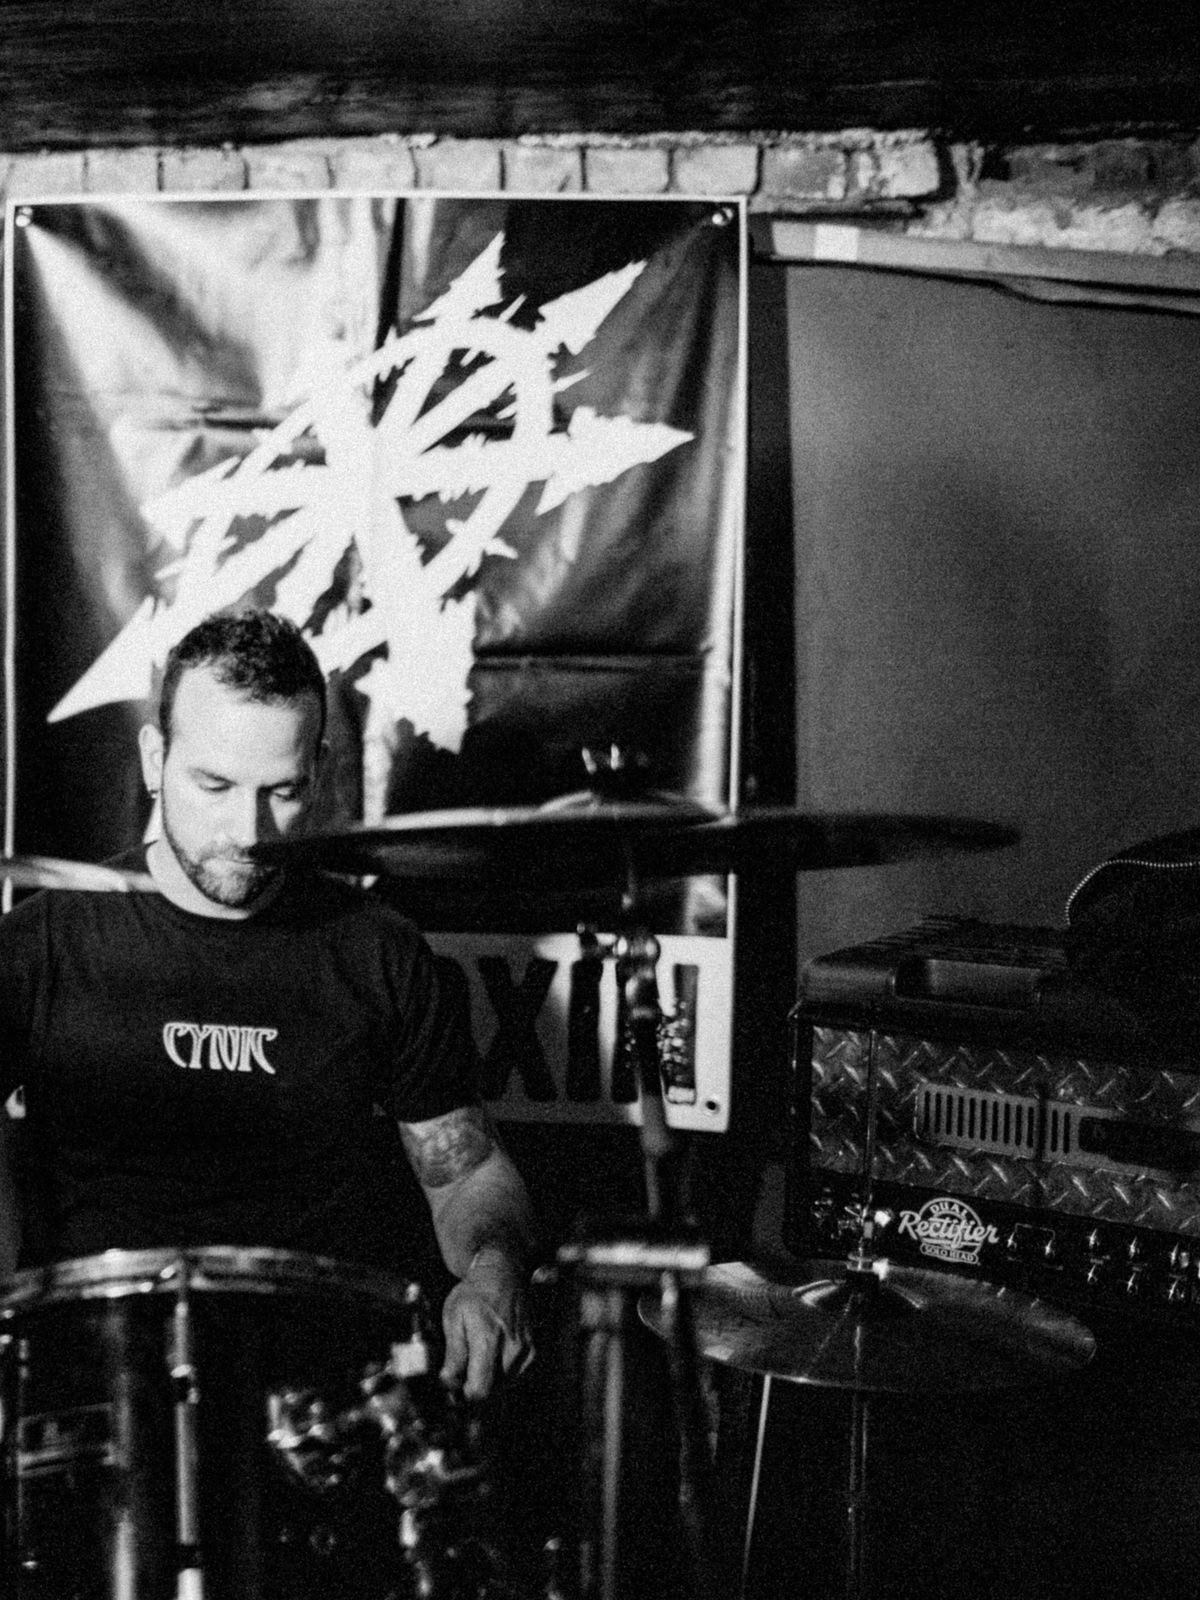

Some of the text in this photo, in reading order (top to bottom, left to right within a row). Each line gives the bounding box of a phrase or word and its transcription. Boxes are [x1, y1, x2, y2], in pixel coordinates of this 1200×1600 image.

[163, 1022, 278, 1075] CYNIC
[929, 1201, 969, 1218] DUAL
[898, 1210, 1000, 1249] Rectifier
